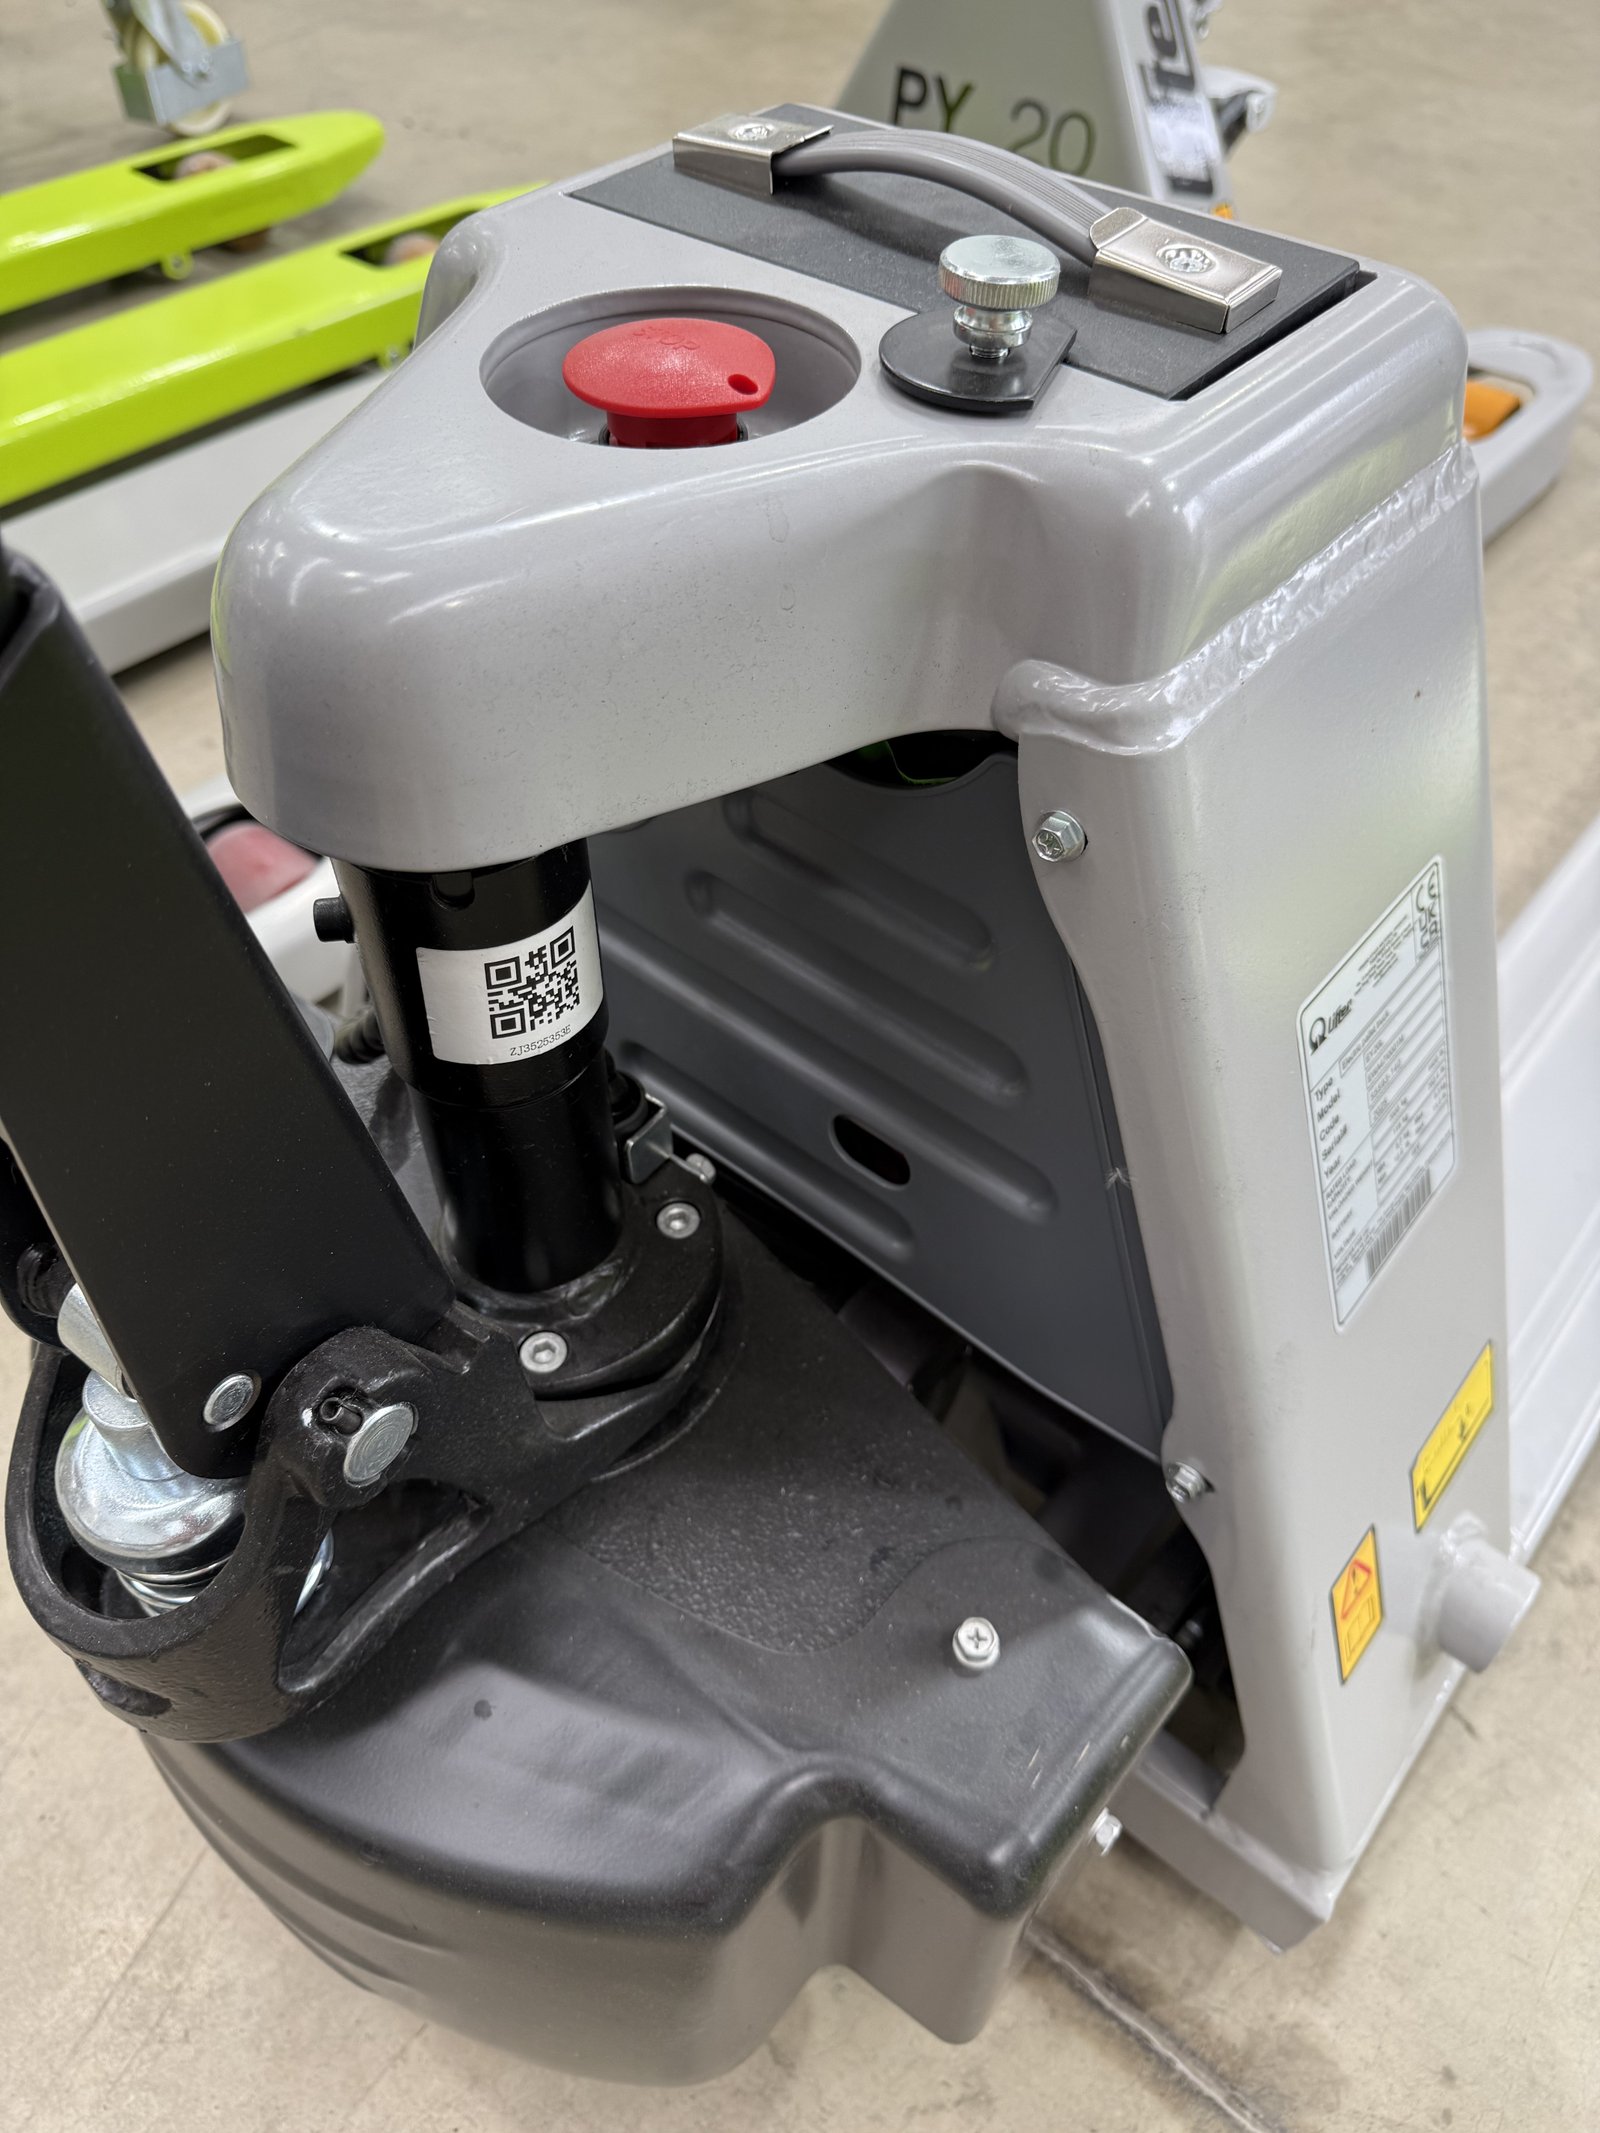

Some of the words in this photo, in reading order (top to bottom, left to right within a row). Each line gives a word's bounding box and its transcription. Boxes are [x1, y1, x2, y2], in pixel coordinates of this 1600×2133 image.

[892, 65, 975, 133] PY
[1007, 98, 1096, 176] 20
[1327, 999, 1352, 1034] Lifter
[510, 1024, 571, 1056] ZJ3525353E
[1315, 1077, 1333, 1101] Type
[1317, 1088, 1340, 1122] Model
[1319, 1114, 1340, 1141] Code
[1324, 1156, 1341, 1179] Year
